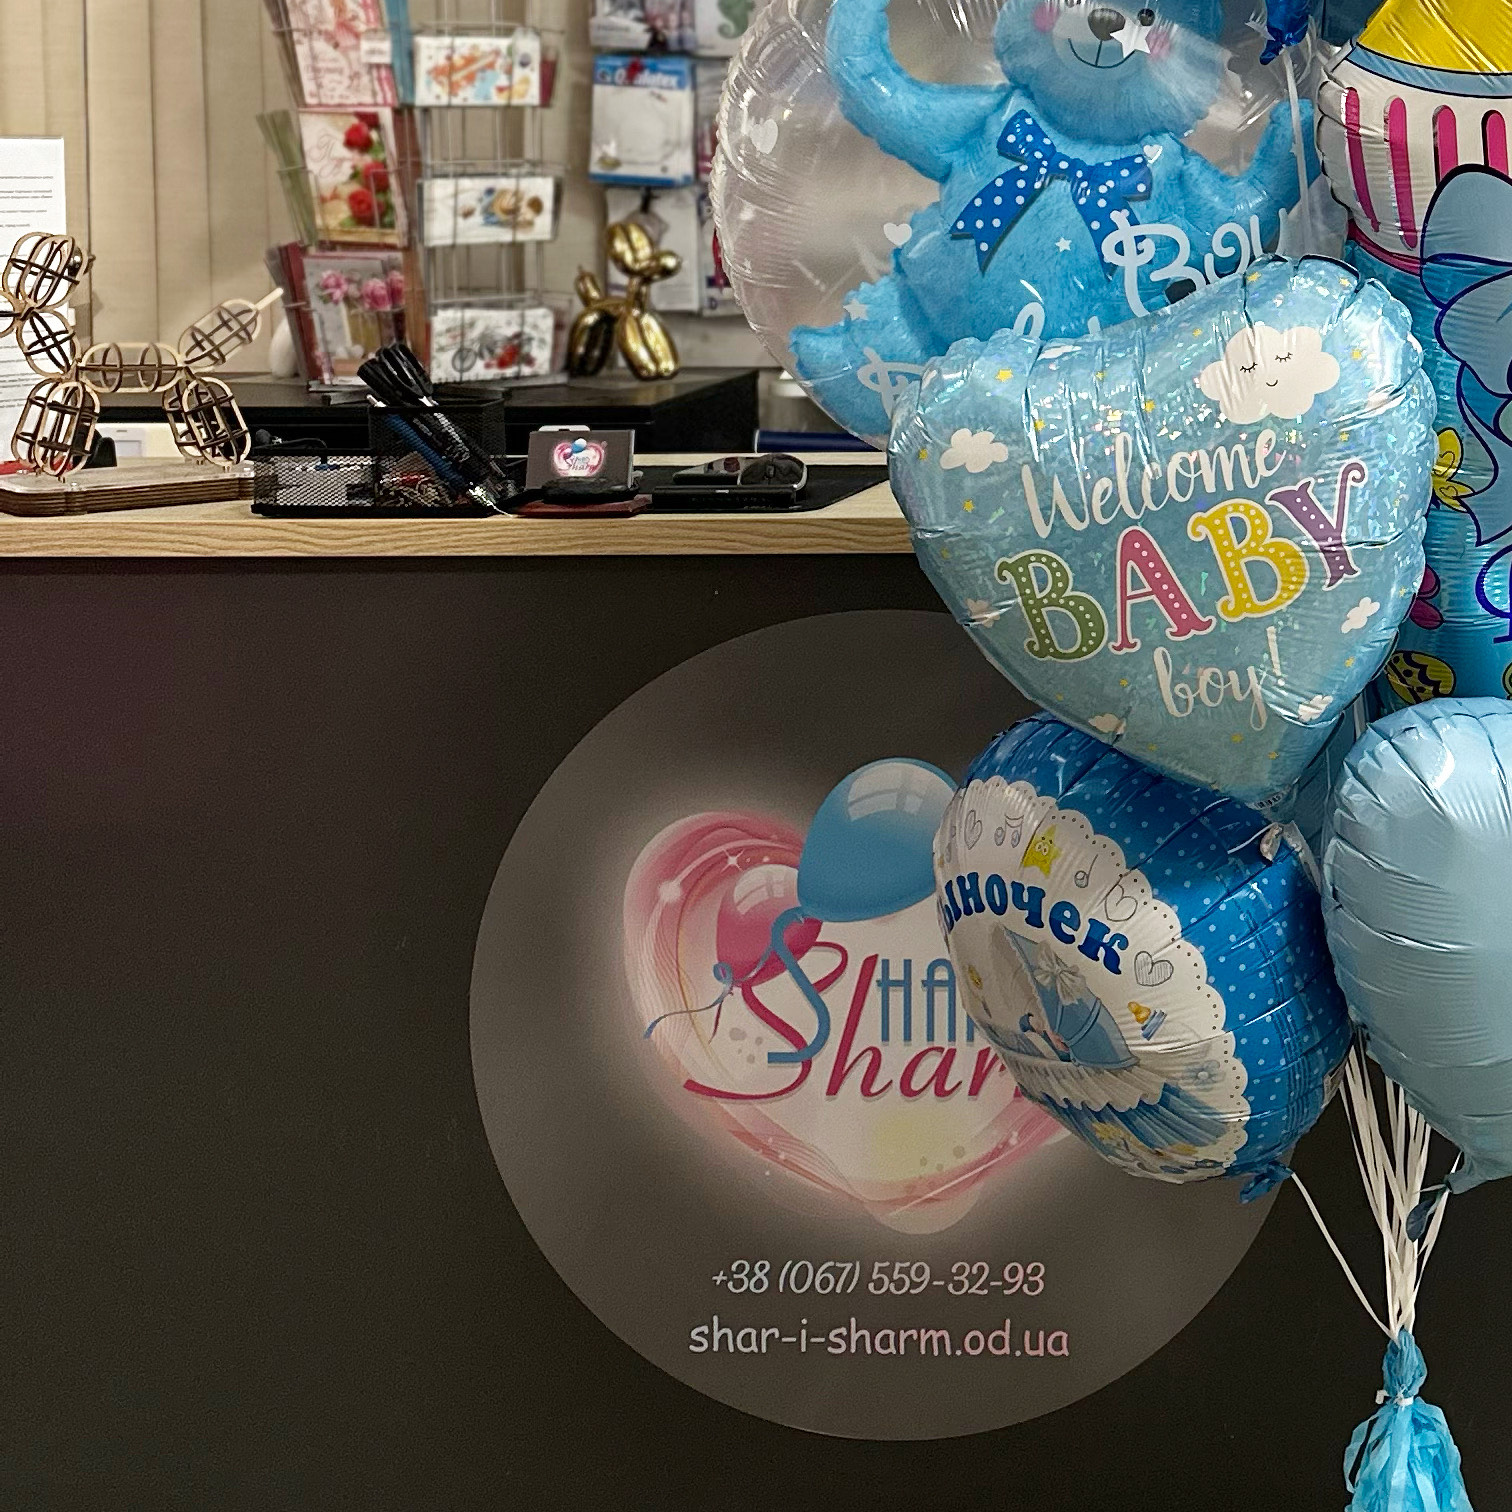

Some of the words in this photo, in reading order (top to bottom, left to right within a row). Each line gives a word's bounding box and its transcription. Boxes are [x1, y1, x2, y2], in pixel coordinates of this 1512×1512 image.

[1021, 428, 1285, 539] Welcome
[994, 460, 1368, 662] BABY
[1153, 626, 1287, 730] boy!
[941, 872, 1129, 975] ыночек
[683, 941, 1024, 1100] Shar
[712, 1260, 771, 1294] +38
[778, 1260, 860, 1294] (067)
[868, 1261, 1046, 1296] 559-32-93
[688, 1315, 1070, 1357] shar-i-sharm.od.ua
